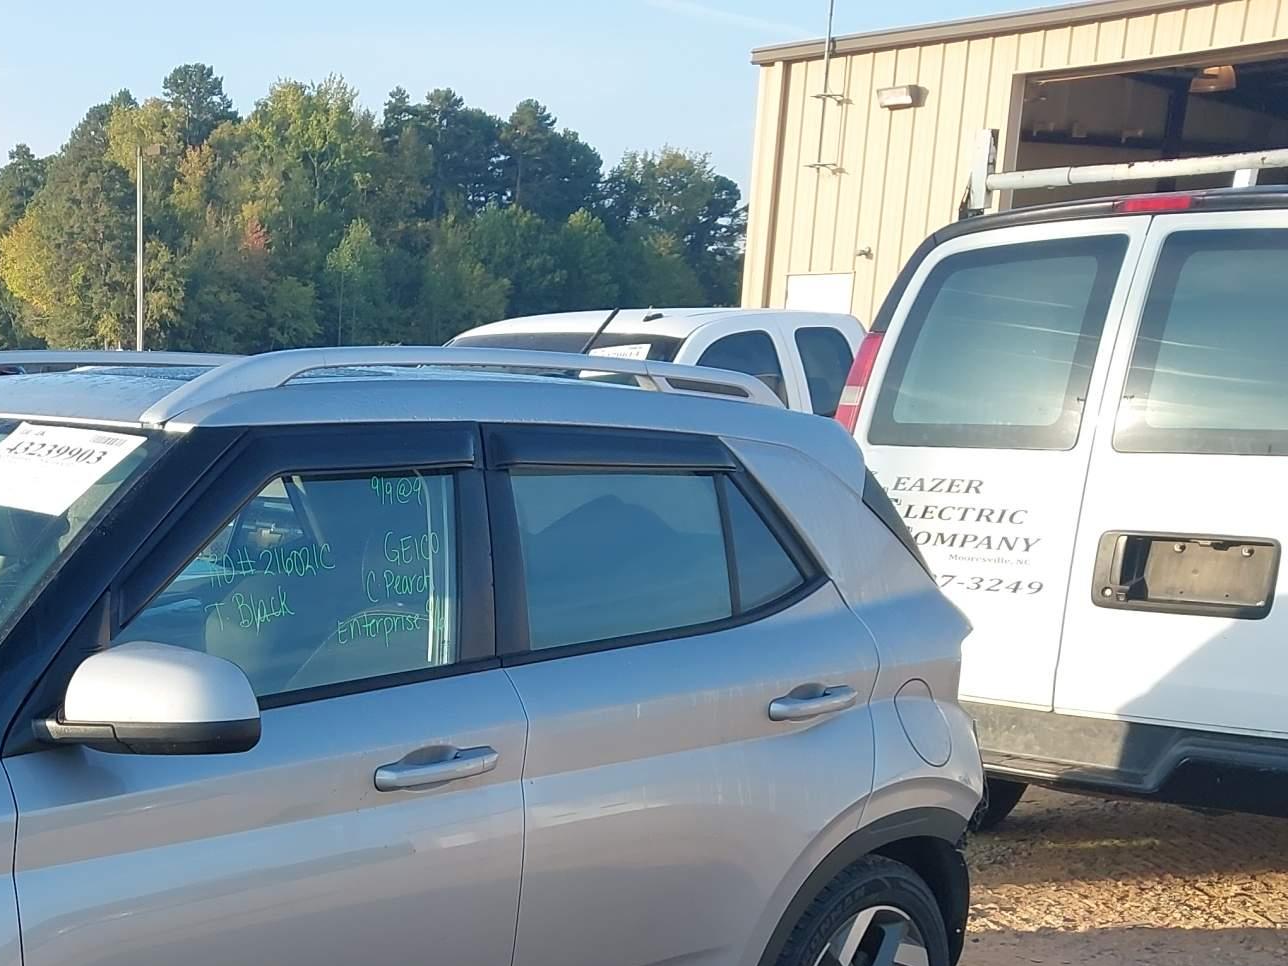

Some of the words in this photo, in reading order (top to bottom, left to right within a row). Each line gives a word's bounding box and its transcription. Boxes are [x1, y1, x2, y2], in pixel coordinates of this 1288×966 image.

[6, 440, 108, 465] 43239903
[884, 474, 984, 495] EAZER
[384, 530, 440, 566] GEICO
[910, 528, 1043, 554] OMPANY
[934, 573, 1044, 597] 7-3249
[232, 585, 296, 637] Black
[336, 612, 421, 648] Enterprise
